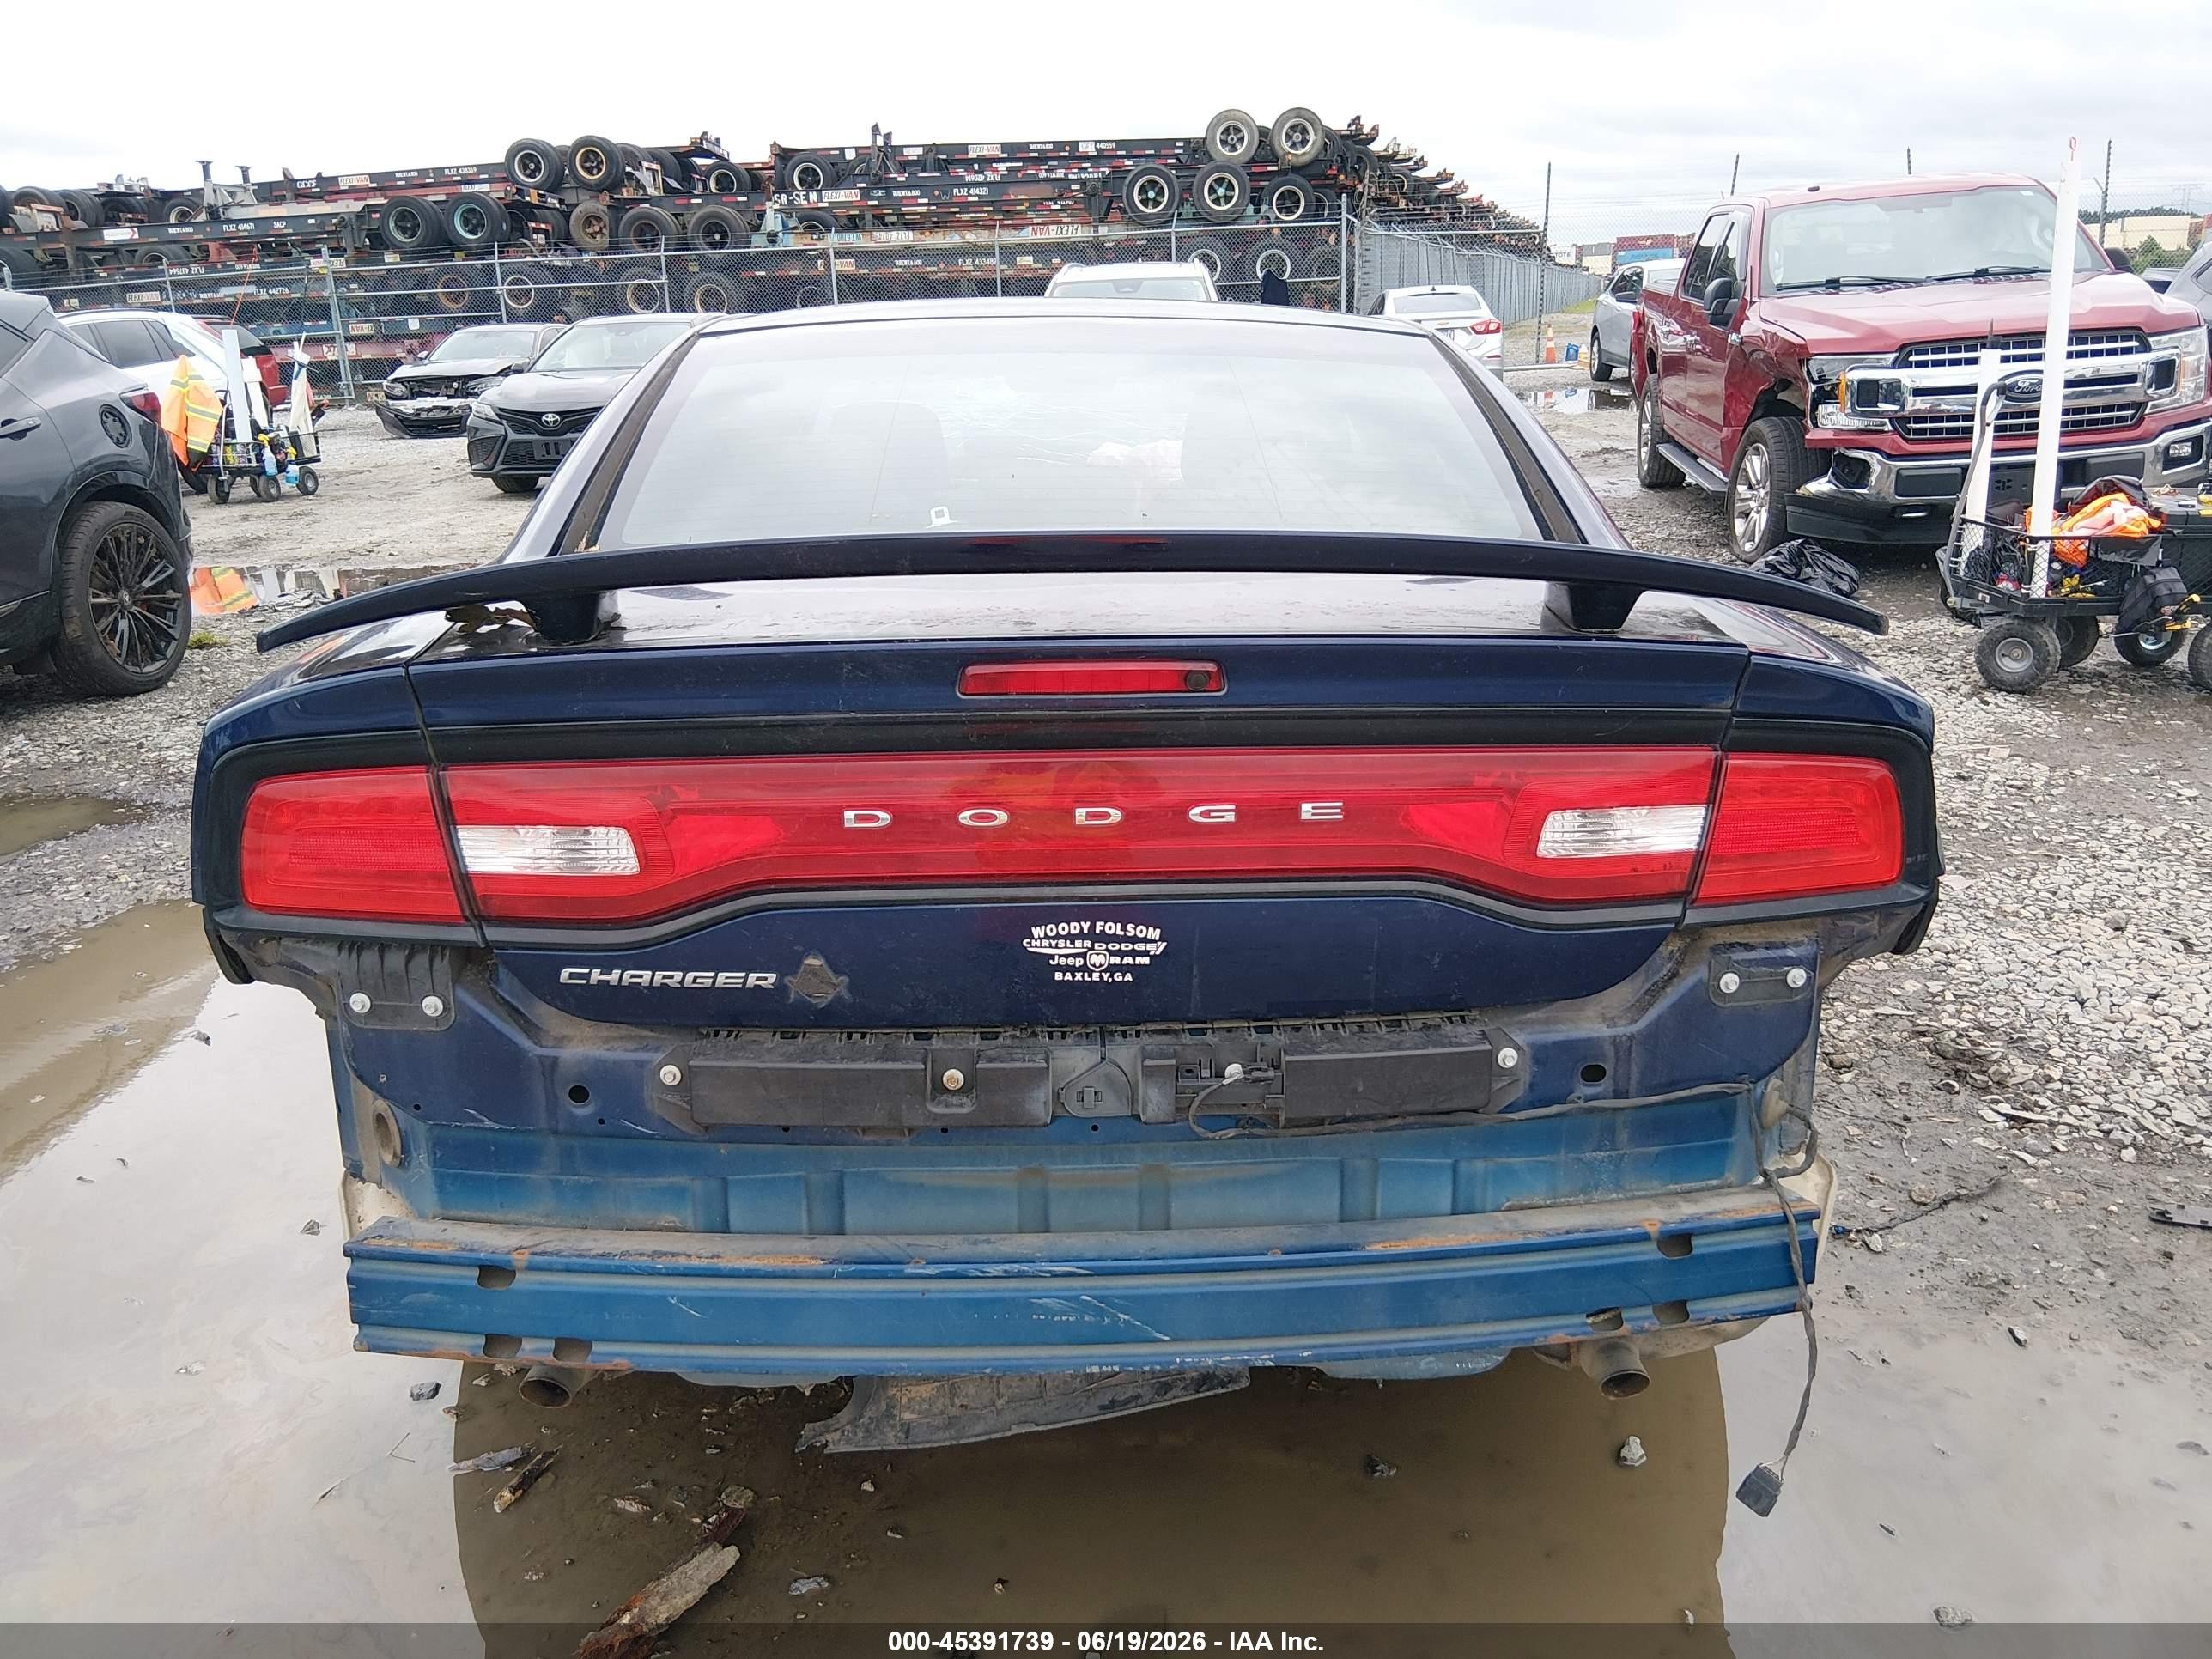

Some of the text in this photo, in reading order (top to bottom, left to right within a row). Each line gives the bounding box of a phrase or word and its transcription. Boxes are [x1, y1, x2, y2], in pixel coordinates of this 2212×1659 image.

[823, 191, 860, 200] FLEXI-VAN
[1030, 225, 1080, 236] FLEXI-VAN
[843, 802, 1344, 828] DODGE
[1031, 921, 1161, 940] WOODY FOLSOM
[1023, 939, 1158, 951] CHRYSLER DODGE
[1049, 955, 1151, 968] Jeep RAM
[559, 967, 777, 989] CHARGER
